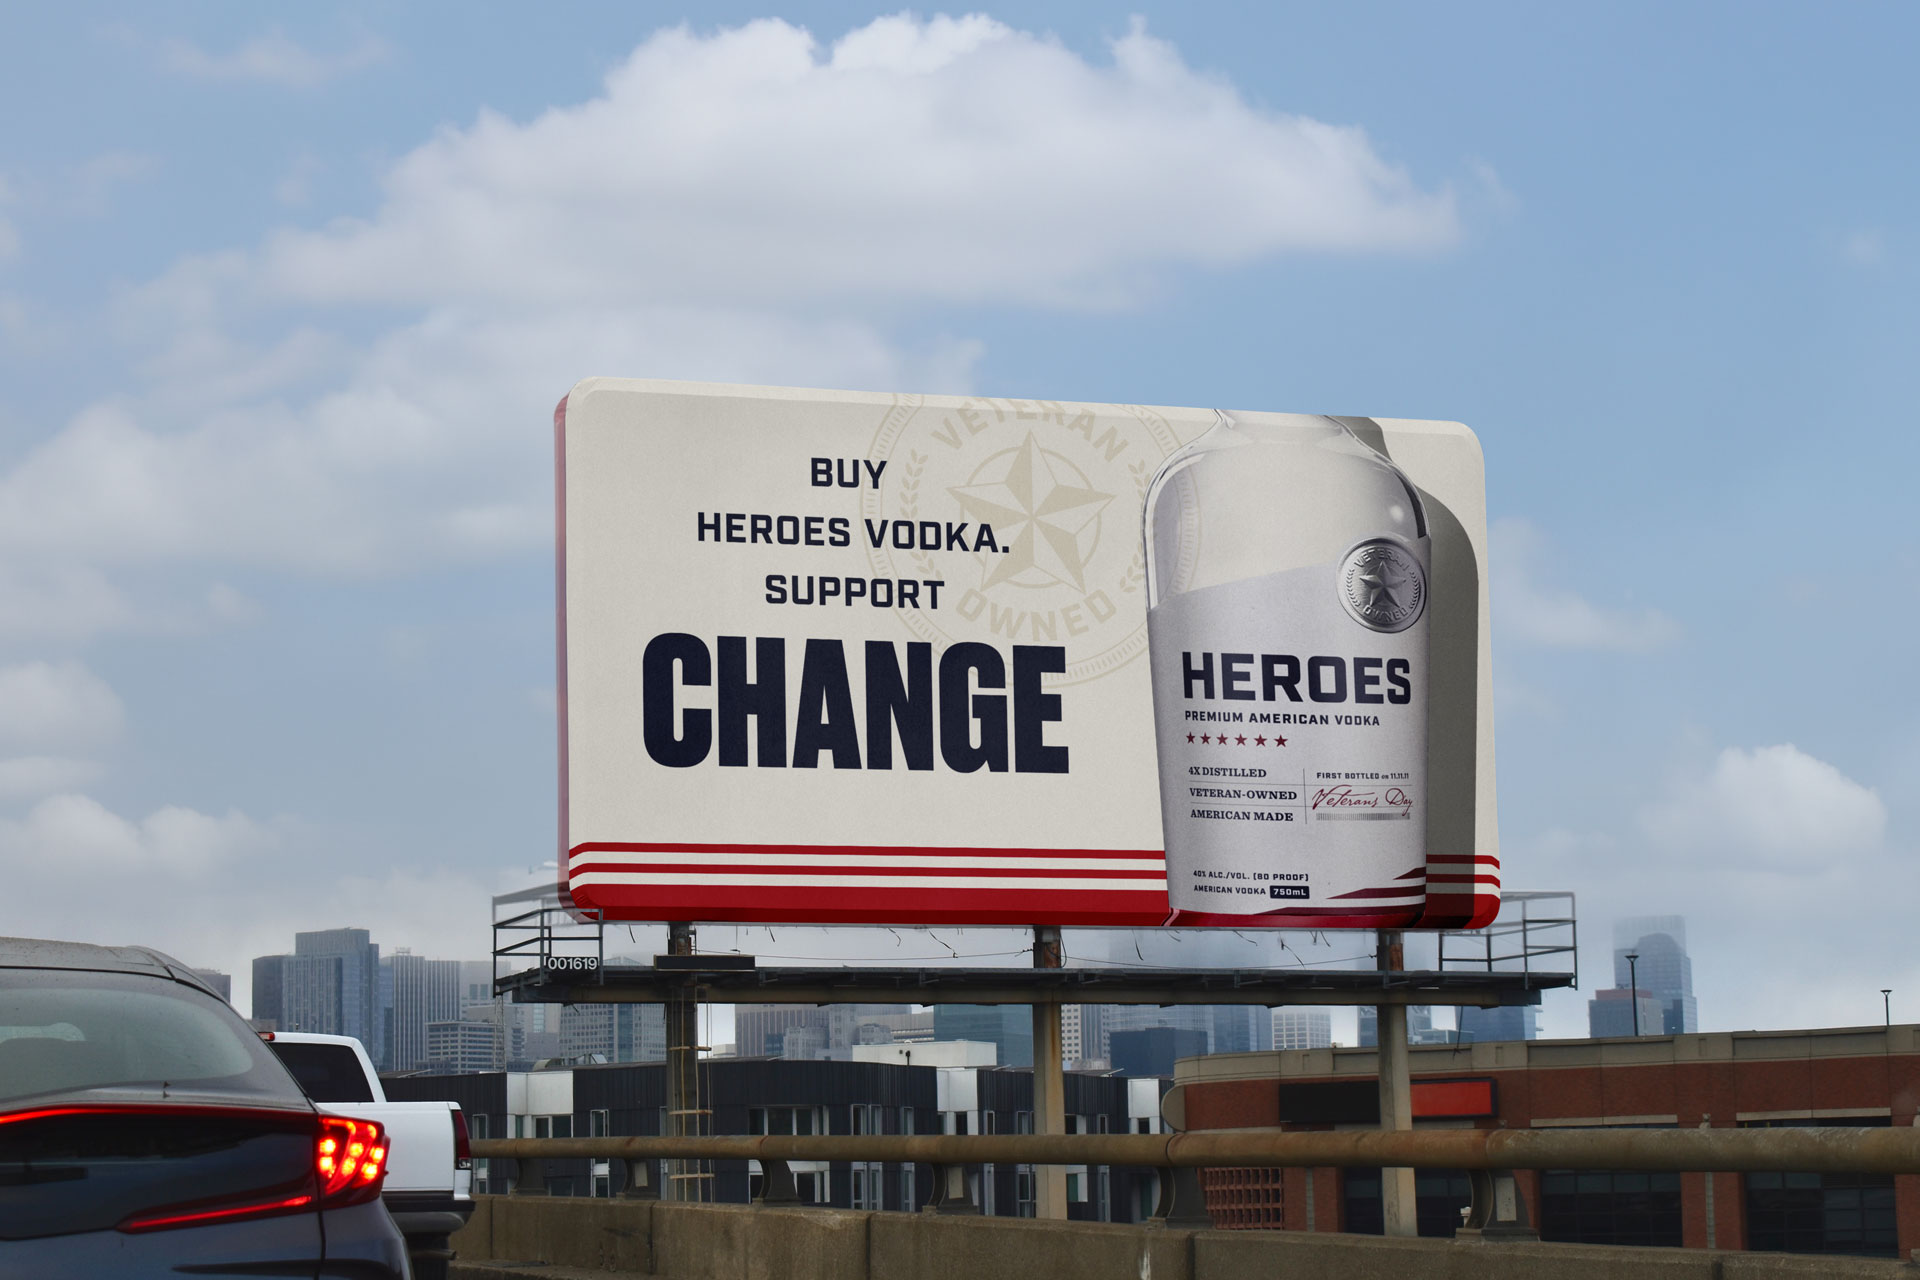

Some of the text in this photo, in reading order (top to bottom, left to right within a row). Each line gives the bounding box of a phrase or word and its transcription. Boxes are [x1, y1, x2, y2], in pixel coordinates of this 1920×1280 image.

[930, 397, 1130, 463] VETERAN
[811, 457, 887, 489] BUY
[697, 511, 1010, 553] HEROES VODKA.
[765, 574, 945, 609] SUPPORT
[956, 588, 1117, 642] OWNED
[1182, 651, 1411, 705] HEROES
[642, 632, 1070, 774] CHANGE
[1185, 710, 1380, 726] PREMIUM AMERICAN VODKA
[1188, 766, 1267, 778] 4X DISTILLED
[1316, 772, 1342, 780] FIRST
[1345, 772, 1380, 780] BOTTLED
[1189, 787, 1298, 800] VETERAN-OWNED
[1312, 784, 1413, 817] Veterans Day
[1190, 809, 1294, 822] AMERICAN MADE
[1193, 870, 1207, 878] 40%
[1208, 871, 1251, 880] ALC./VOL.
[1193, 884, 1307, 896] AMERICAN VODKA 750mL
[547, 957, 598, 970] 001619
